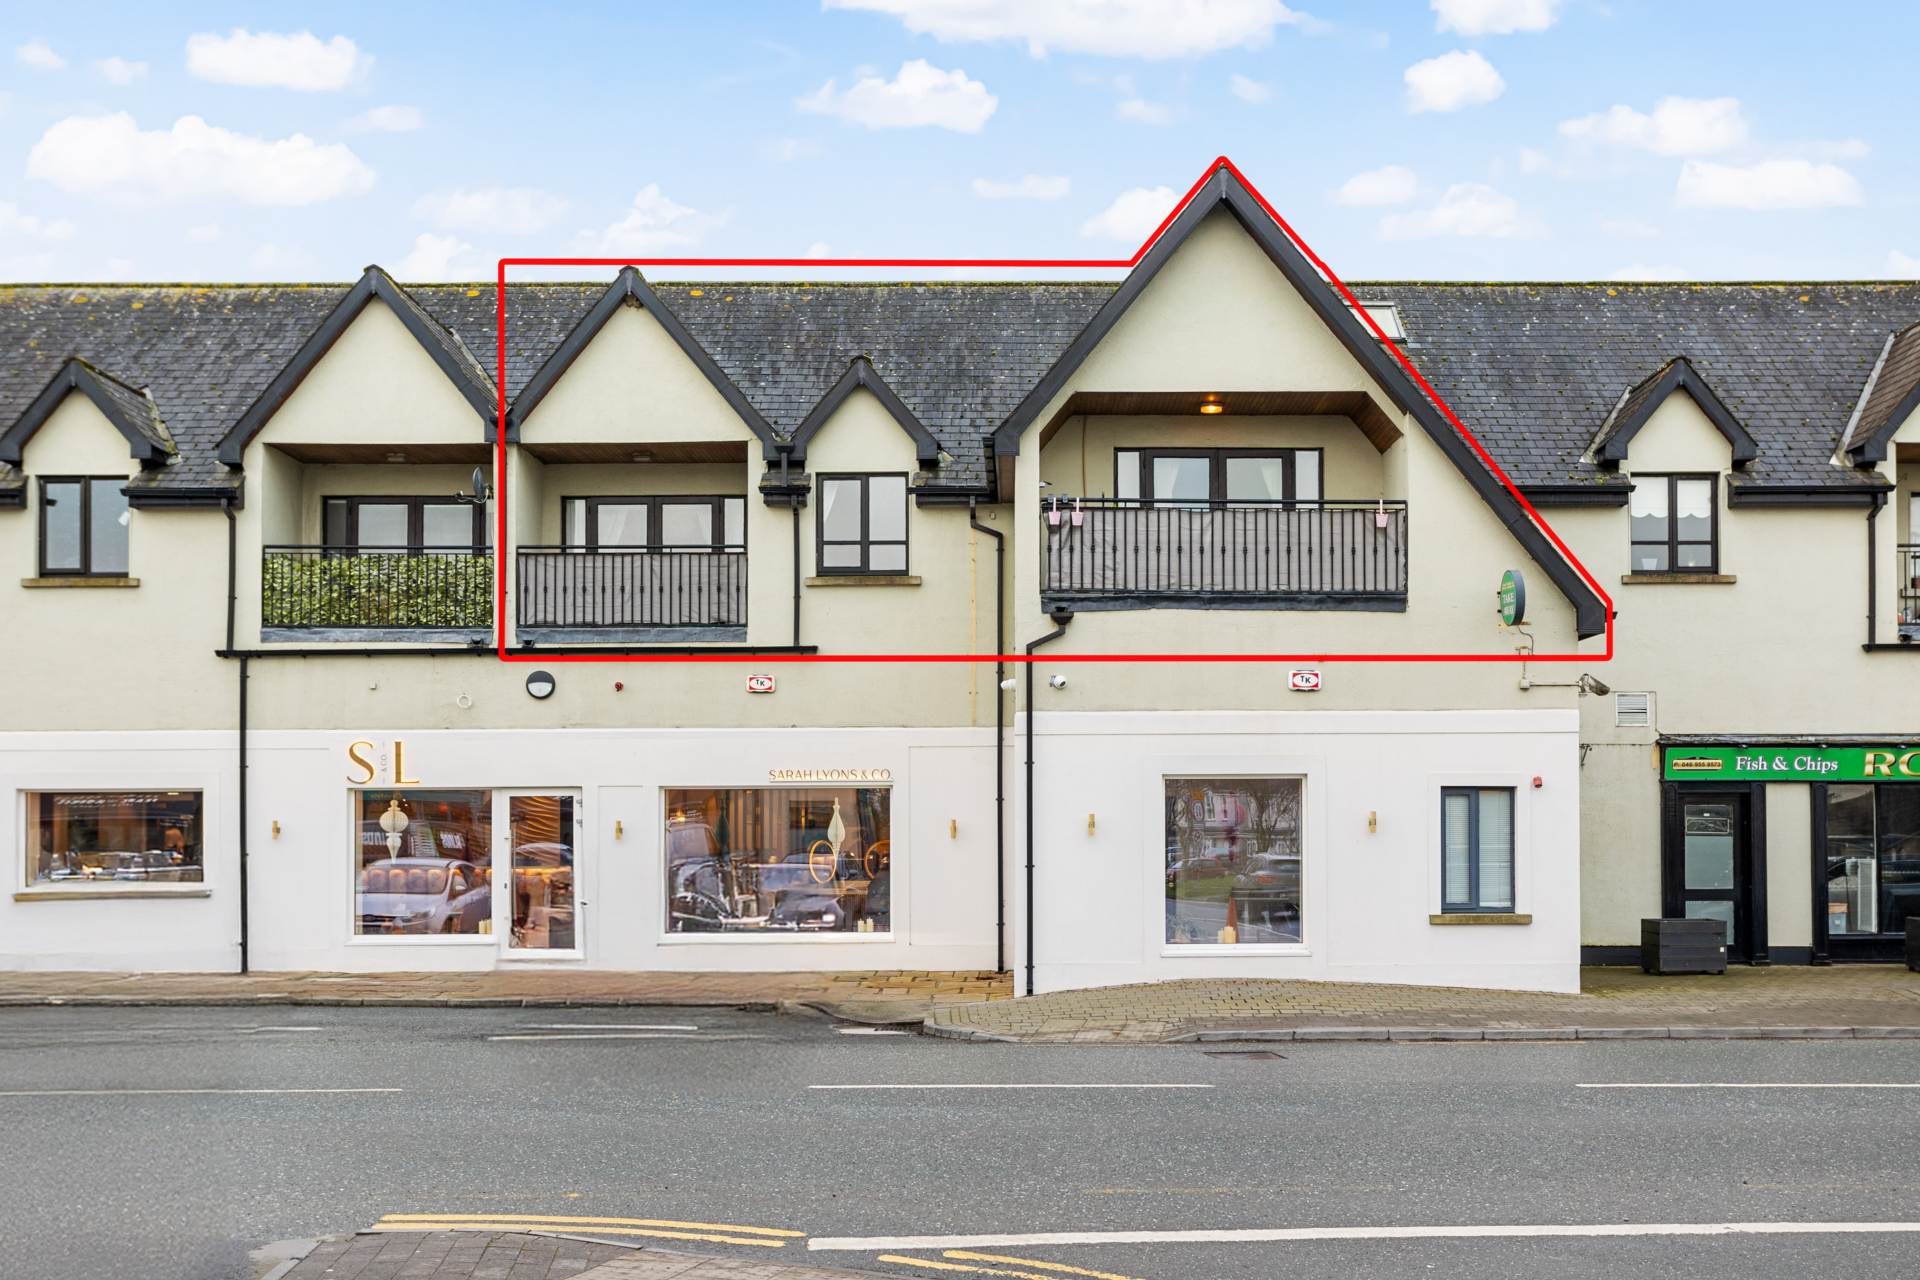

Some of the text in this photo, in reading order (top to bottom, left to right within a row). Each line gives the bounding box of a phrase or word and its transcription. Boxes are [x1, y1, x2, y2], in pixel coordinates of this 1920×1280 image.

[1300, 675, 1311, 684] TK
[1735, 756, 1838, 774] Fish & Chips
[768, 769, 812, 780] SARAH
[816, 769, 858, 780] LYONS
[860, 769, 869, 779] &
